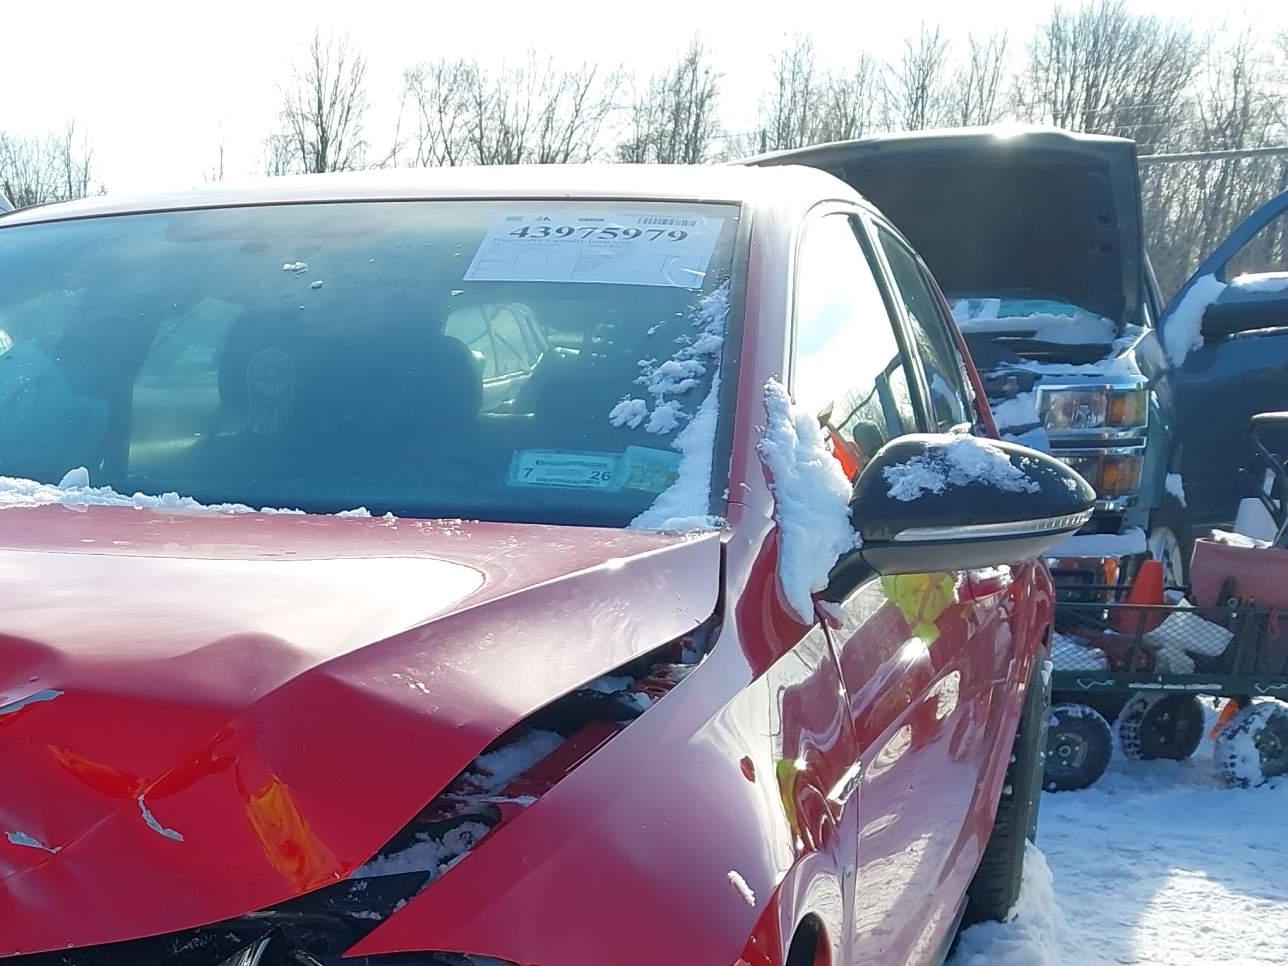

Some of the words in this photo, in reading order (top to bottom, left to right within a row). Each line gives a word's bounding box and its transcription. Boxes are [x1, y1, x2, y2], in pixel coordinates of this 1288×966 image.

[509, 225, 689, 242] 43975979
[523, 467, 534, 479] 7
[589, 470, 612, 481] 26
